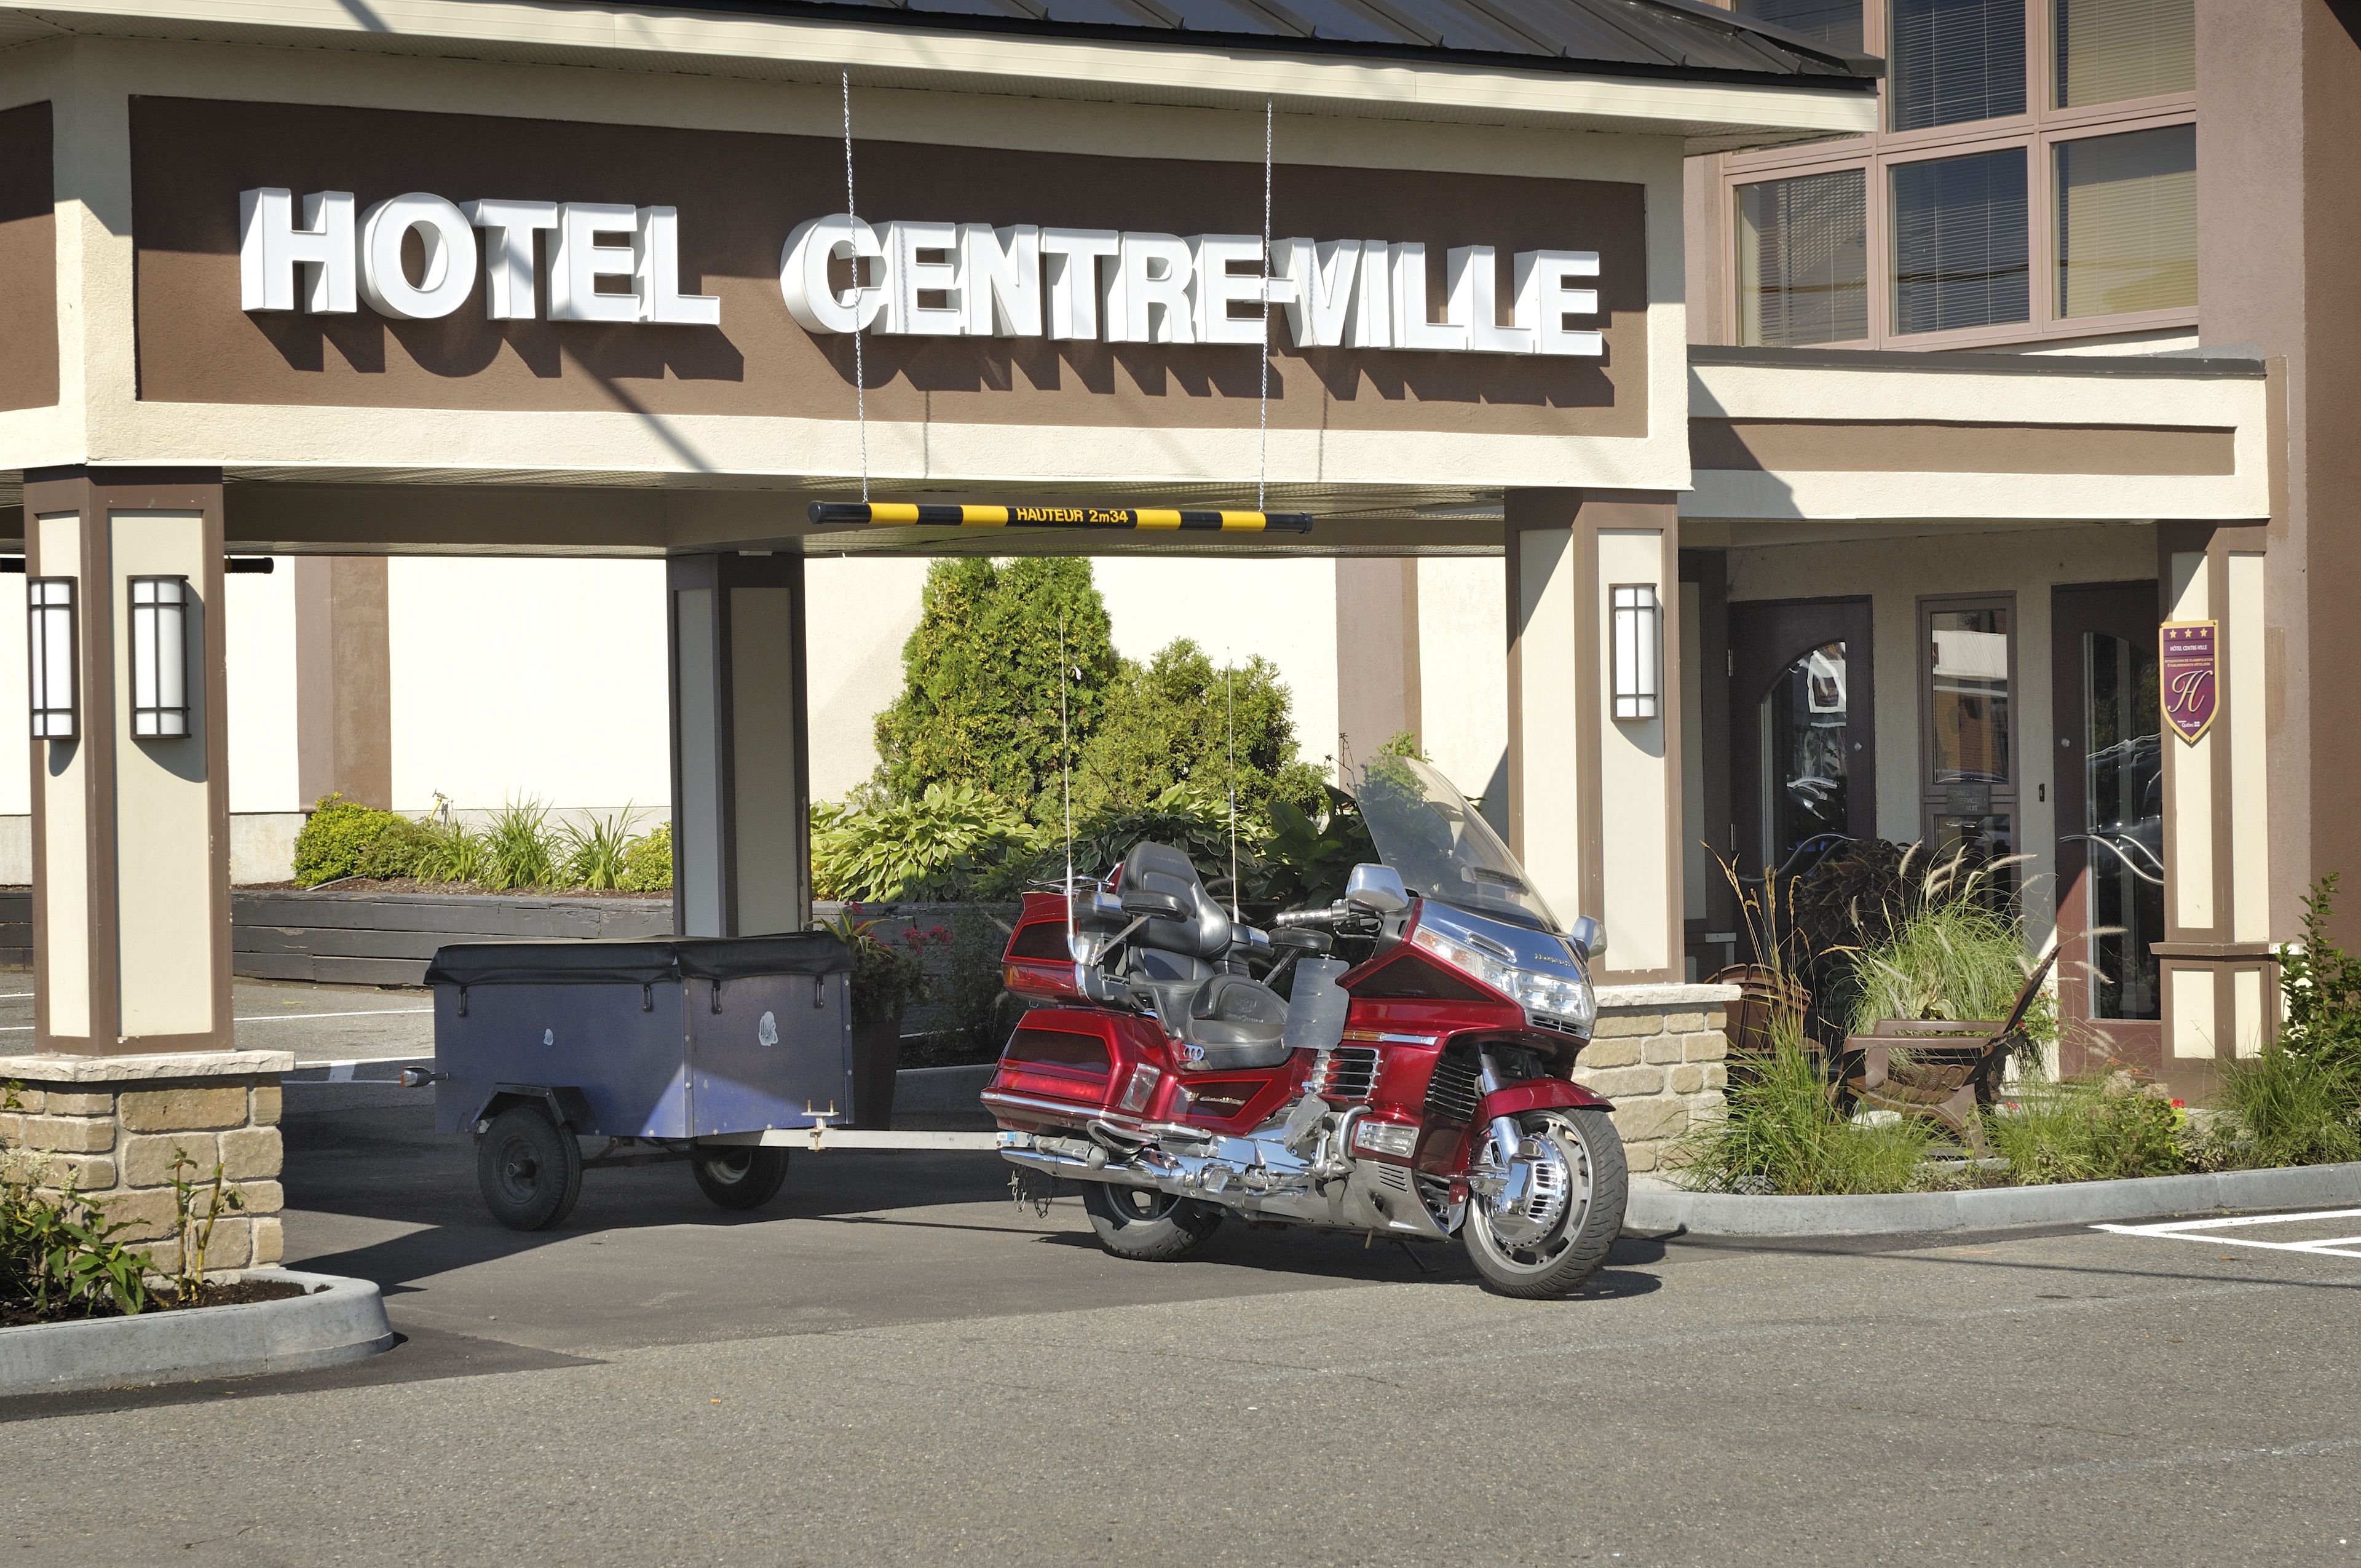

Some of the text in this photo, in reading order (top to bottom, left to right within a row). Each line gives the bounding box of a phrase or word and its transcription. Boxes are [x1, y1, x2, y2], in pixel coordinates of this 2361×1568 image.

[240, 187, 1602, 357] HOTEL CENTRE-VILLE
[1016, 507, 1129, 523] HAUTEUR 2m34
[2167, 670, 2213, 713] H
